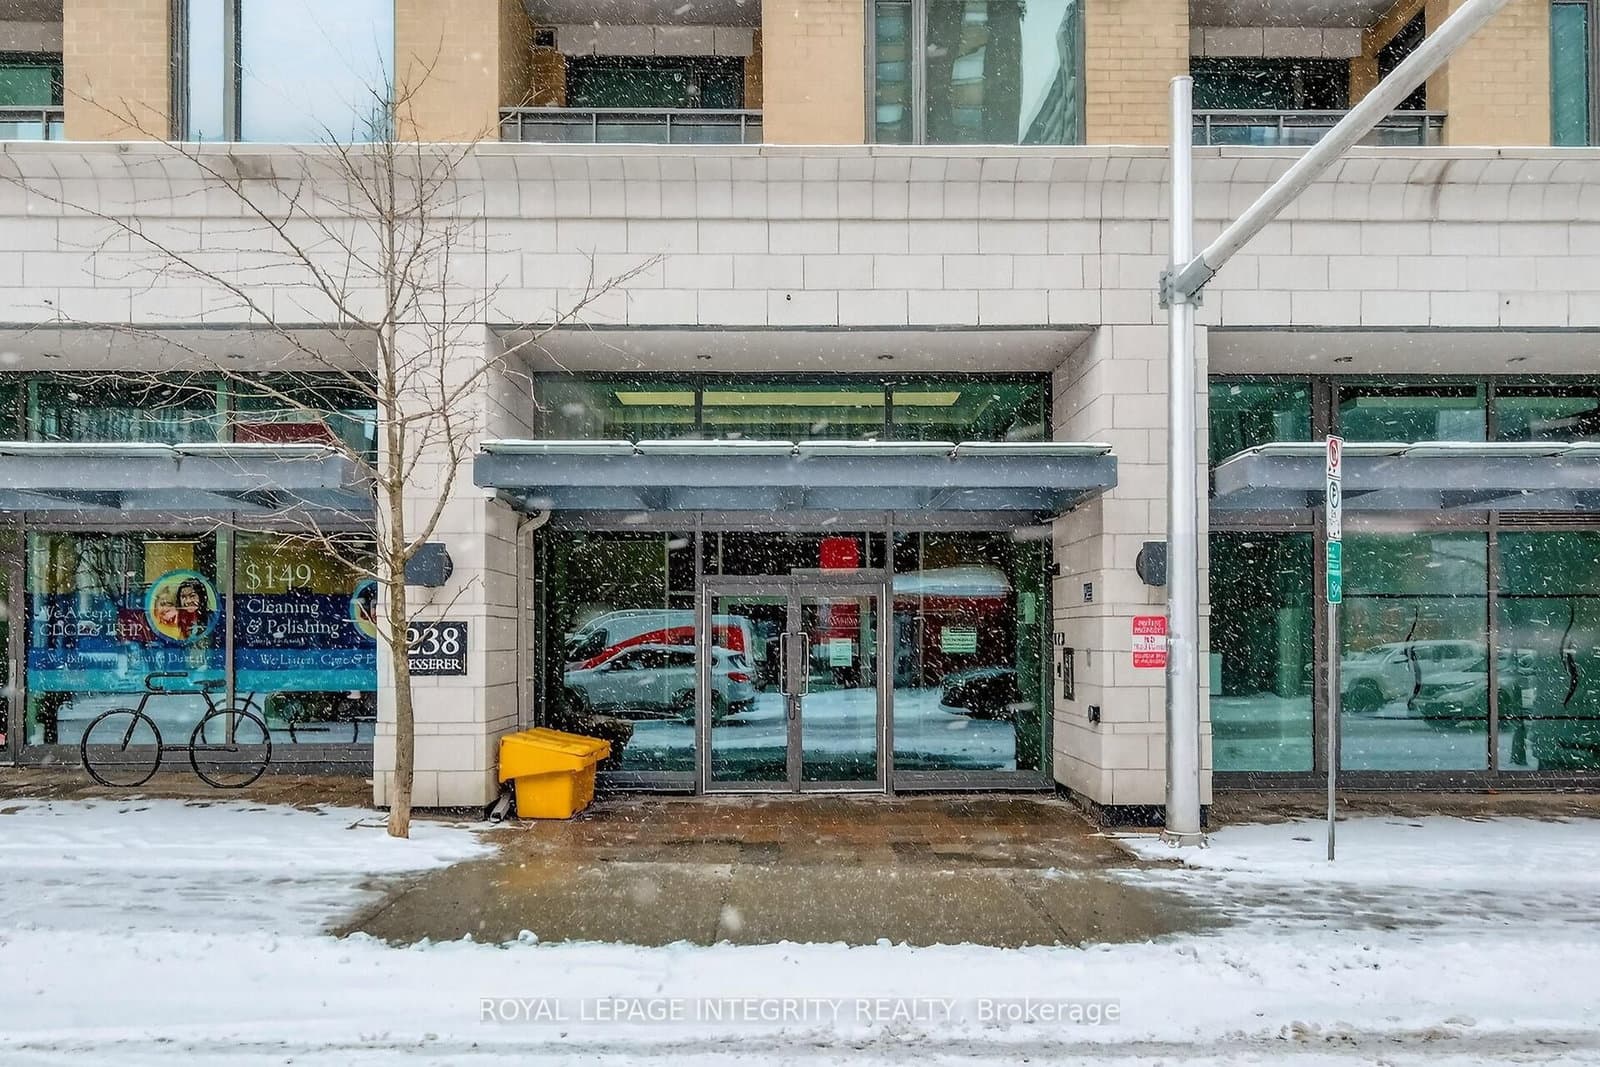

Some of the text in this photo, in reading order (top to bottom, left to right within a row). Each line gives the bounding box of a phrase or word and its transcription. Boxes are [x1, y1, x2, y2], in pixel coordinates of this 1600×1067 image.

[246, 563, 312, 594] $149
[246, 598, 320, 618] Cleaning
[246, 619, 340, 638] & Polishing
[406, 627, 460, 655] 238
[408, 658, 462, 670] ESSERER
